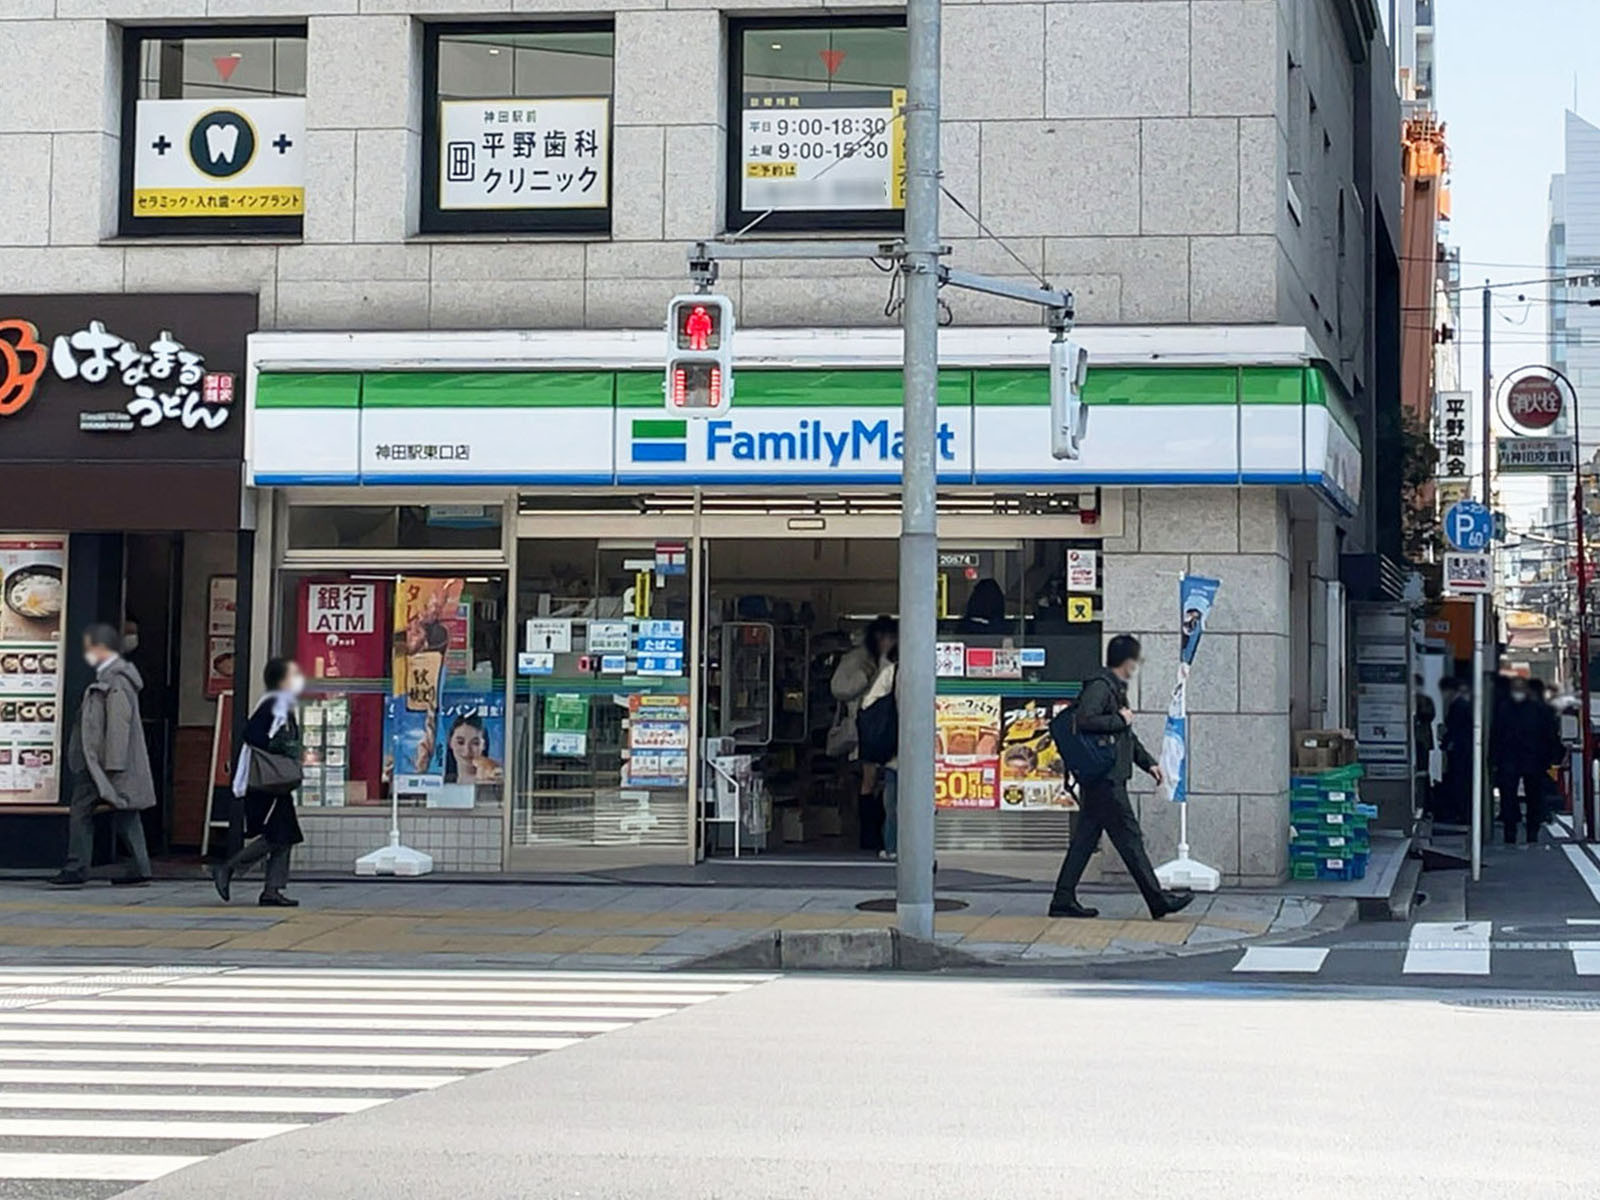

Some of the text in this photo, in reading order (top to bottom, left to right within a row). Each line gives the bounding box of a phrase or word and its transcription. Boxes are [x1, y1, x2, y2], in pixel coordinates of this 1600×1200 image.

[484, 110, 537, 123] 神田駅前
[749, 117, 887, 136] 平日 9:00-18:30
[482, 128, 598, 159] 平野歯科
[749, 141, 888, 159] 土曜 9:00-15:30
[483, 165, 598, 194] クリニック
[52, 320, 205, 386] はなまる
[127, 384, 229, 430] うどん
[1512, 391, 1558, 413] 消火栓
[375, 444, 470, 460] 神田駅東口店
[707, 419, 954, 467] FamilyMat
[1456, 513, 1474, 546] P
[317, 586, 367, 610] 銀行
[316, 614, 365, 630] ATM
